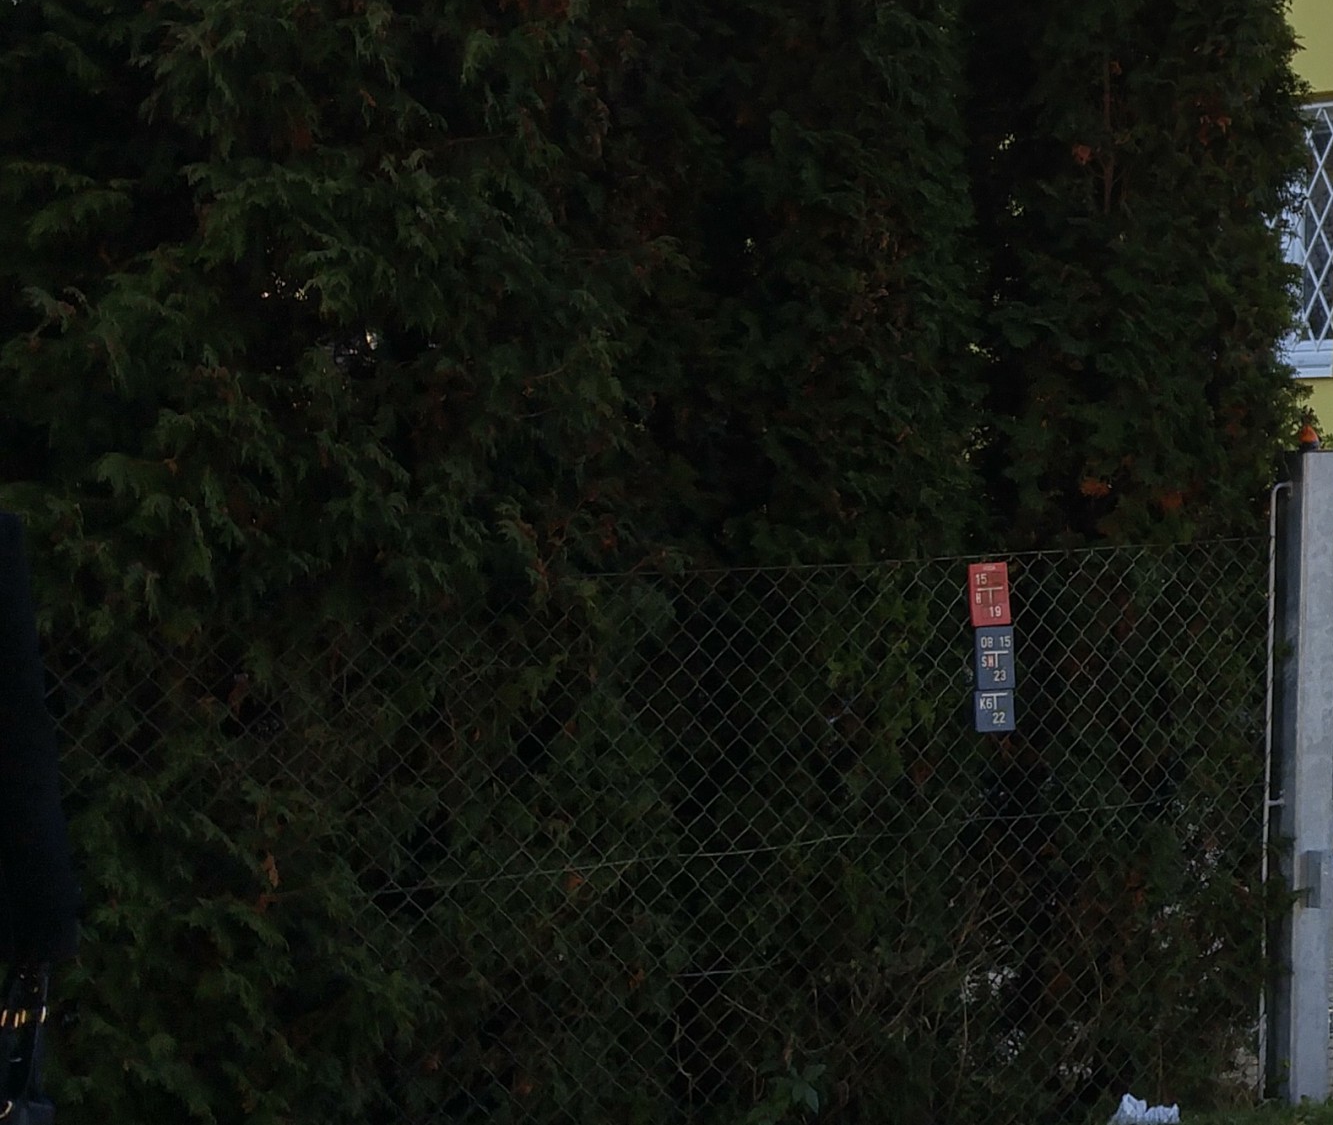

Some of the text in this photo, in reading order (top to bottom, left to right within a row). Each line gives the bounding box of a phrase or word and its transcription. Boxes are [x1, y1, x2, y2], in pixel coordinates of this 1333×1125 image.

[975, 573, 987, 585] 15
[989, 605, 1002, 617] 19
[1000, 636, 1011, 648] 15
[993, 670, 1007, 682] 23
[992, 712, 1006, 724] 22
